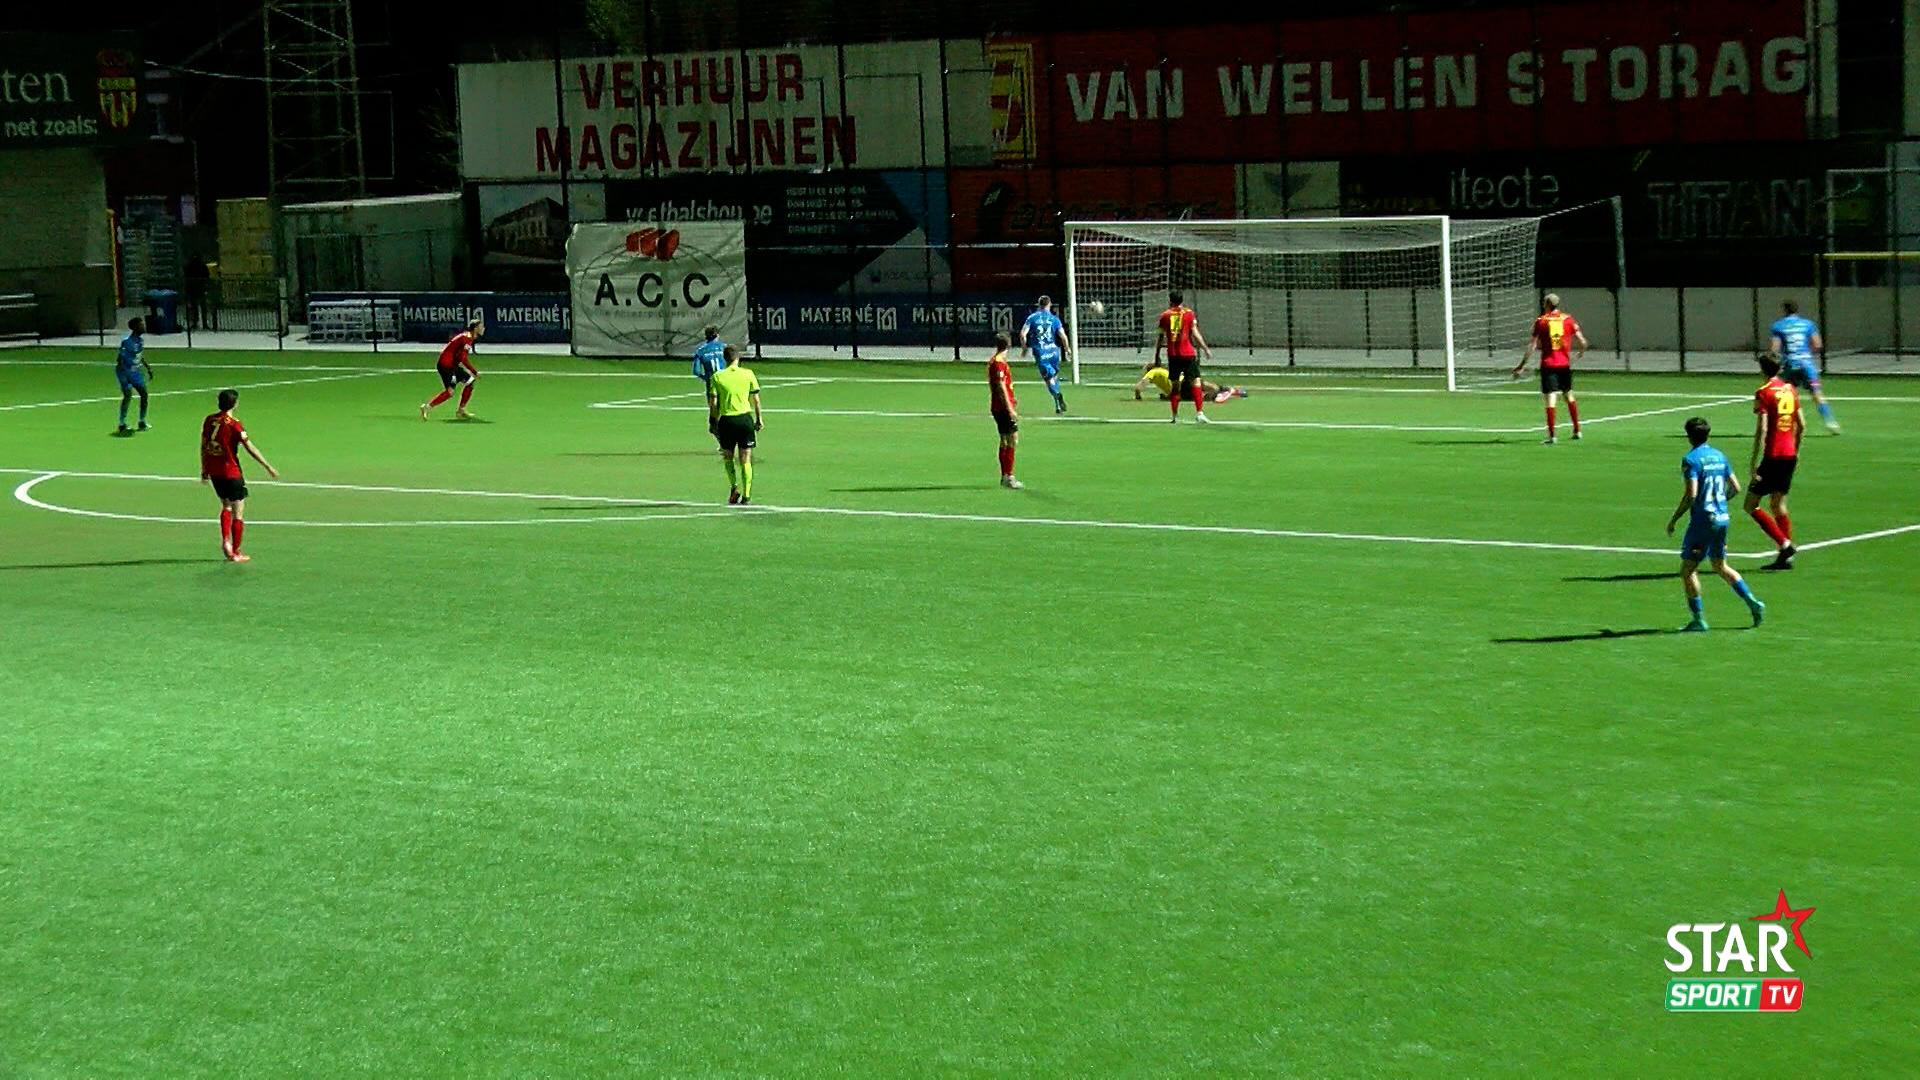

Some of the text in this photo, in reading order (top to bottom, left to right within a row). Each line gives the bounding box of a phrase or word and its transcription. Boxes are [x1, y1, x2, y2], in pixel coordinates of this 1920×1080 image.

[577, 53, 804, 109] VERHUUR
[1066, 67, 1184, 123] VAN
[1217, 54, 1478, 117] WELLEN
[535, 115, 857, 173] MAGAZIJNEN
[402, 303, 465, 322] MATERNÉ
[496, 303, 560, 323] MATERNÉ
[594, 272, 726, 308] A.C.C.
